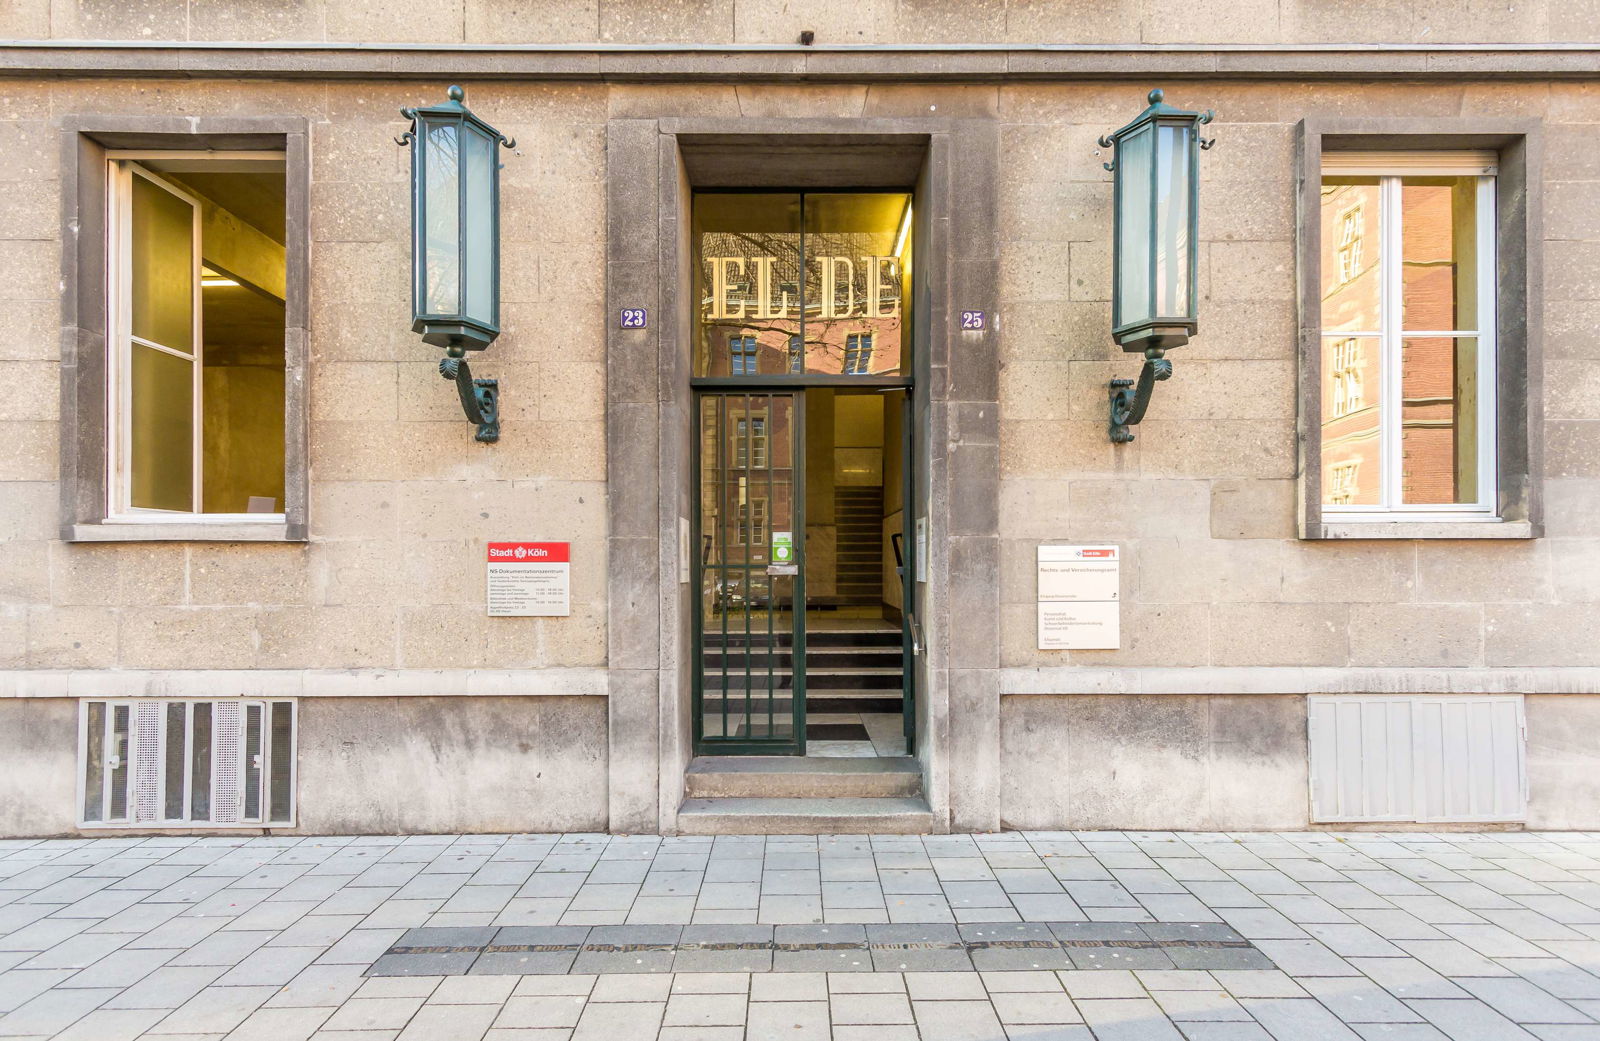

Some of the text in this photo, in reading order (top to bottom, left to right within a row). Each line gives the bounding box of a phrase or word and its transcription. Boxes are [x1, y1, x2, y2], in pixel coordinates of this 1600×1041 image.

[706, 256, 901, 319] EL DE
[623, 310, 644, 326] 23
[963, 312, 983, 328] 25
[489, 548, 548, 557] Stadt Köln
